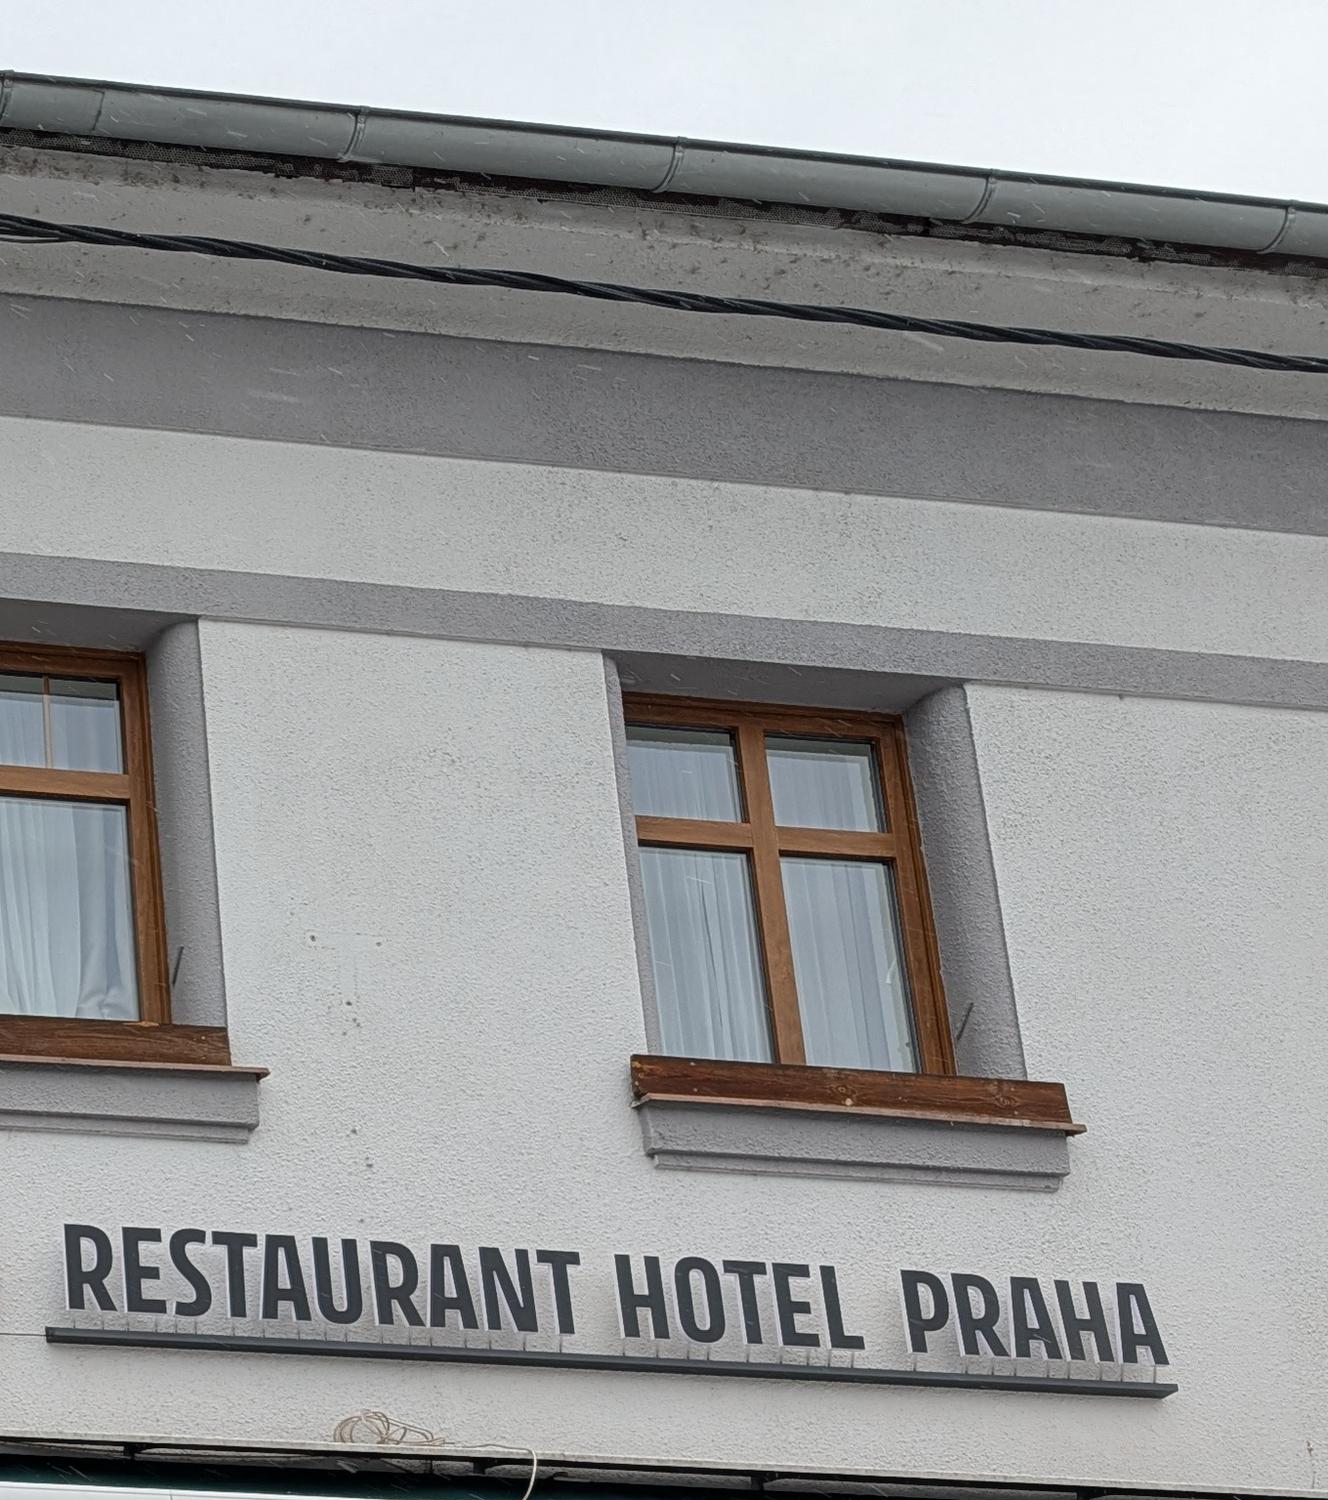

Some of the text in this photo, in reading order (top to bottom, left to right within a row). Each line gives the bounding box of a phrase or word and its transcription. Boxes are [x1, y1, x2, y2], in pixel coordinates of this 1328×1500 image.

[62, 1222, 1171, 1367] RESTAURANT HOTEL PRAHA
